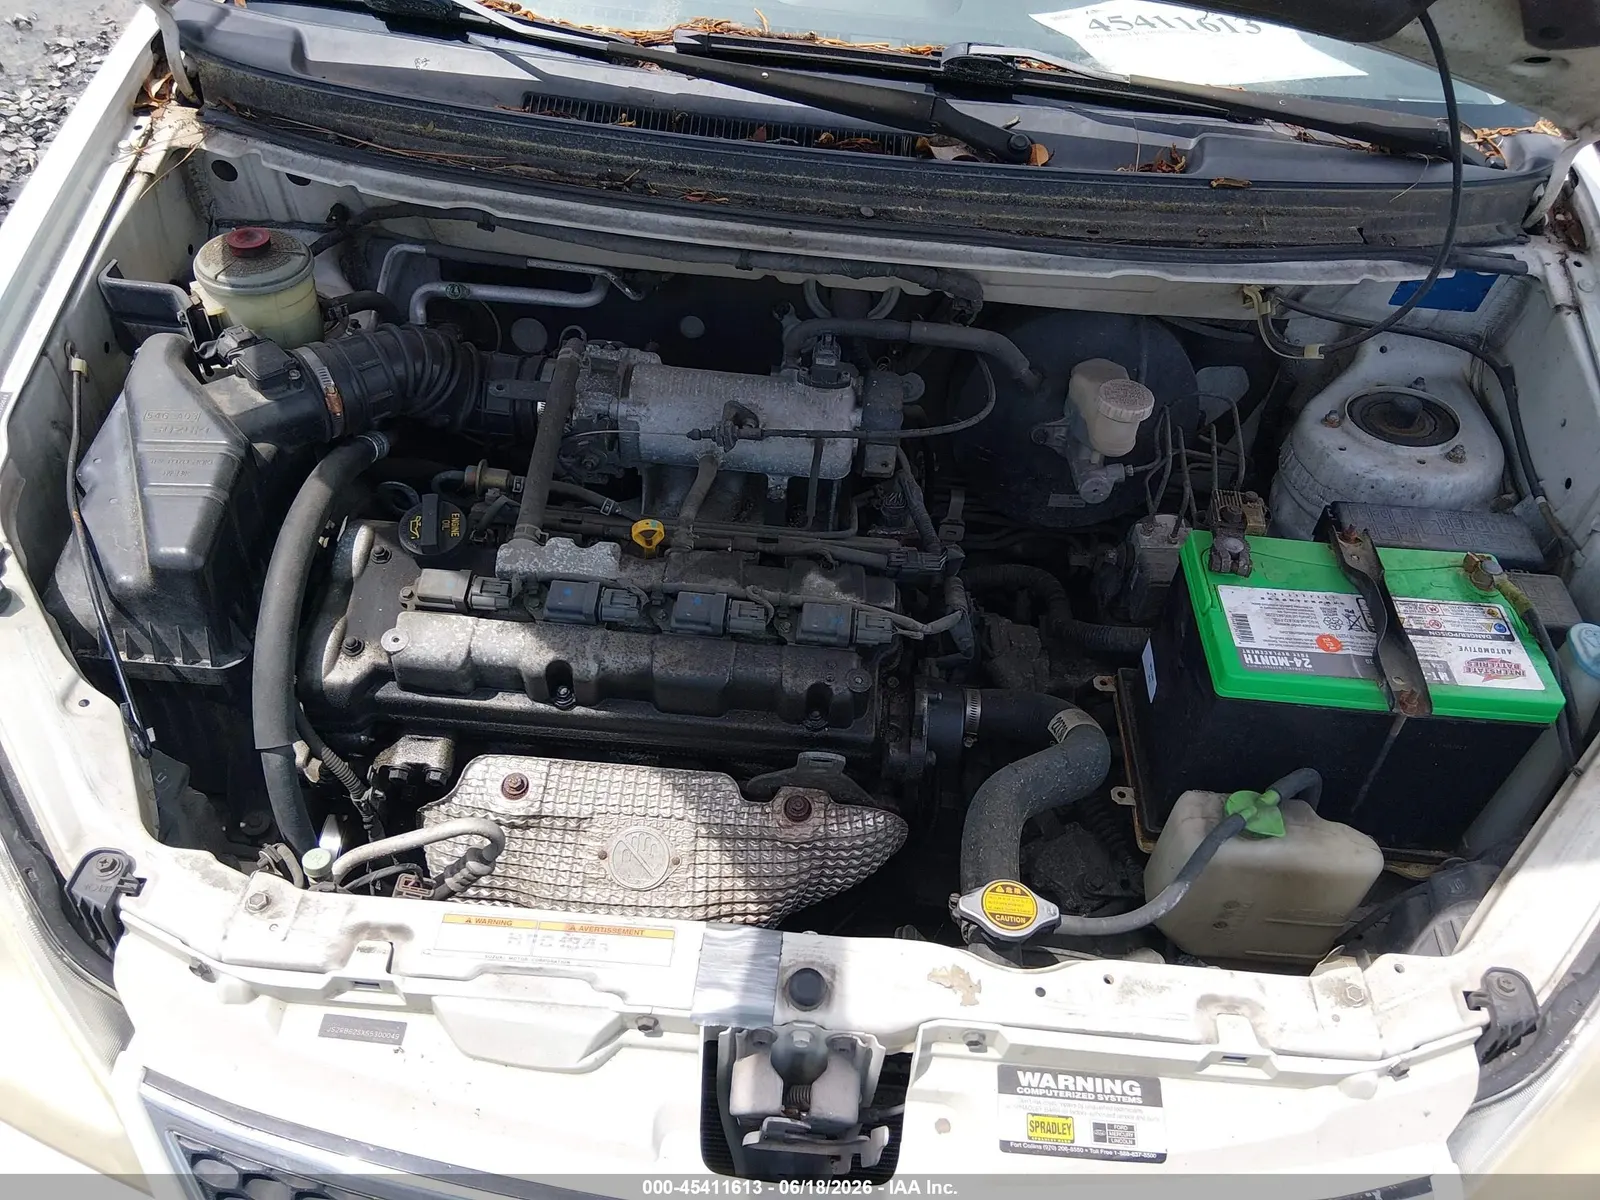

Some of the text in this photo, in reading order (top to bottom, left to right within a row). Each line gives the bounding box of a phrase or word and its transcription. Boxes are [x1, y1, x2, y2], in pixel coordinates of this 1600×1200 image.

[1088, 14, 1262, 35] 45411613
[441, 520, 451, 531] OIL
[451, 513, 460, 537] ENGINE
[1428, 630, 1492, 640] DANGER/POISON
[1242, 649, 1290, 657] REPLACEMENT
[1458, 645, 1512, 655] AUTOMOTIVE
[1243, 653, 1313, 669] 24-MONTH
[1465, 661, 1521, 670] BATTERIES
[1463, 667, 1526, 677] INTERSTATE
[474, 917, 513, 927] WARNING
[995, 914, 1026, 924] CAUTION
[578, 924, 646, 937] AVERTISSEMENT
[1016, 1070, 1143, 1096] WARNING
[1016, 1086, 1143, 1104] COMPUTERIZED SYSTEMS
[1029, 1119, 1072, 1136] SPRADLEY
[1022, 1142, 1042, 1150] Collins
